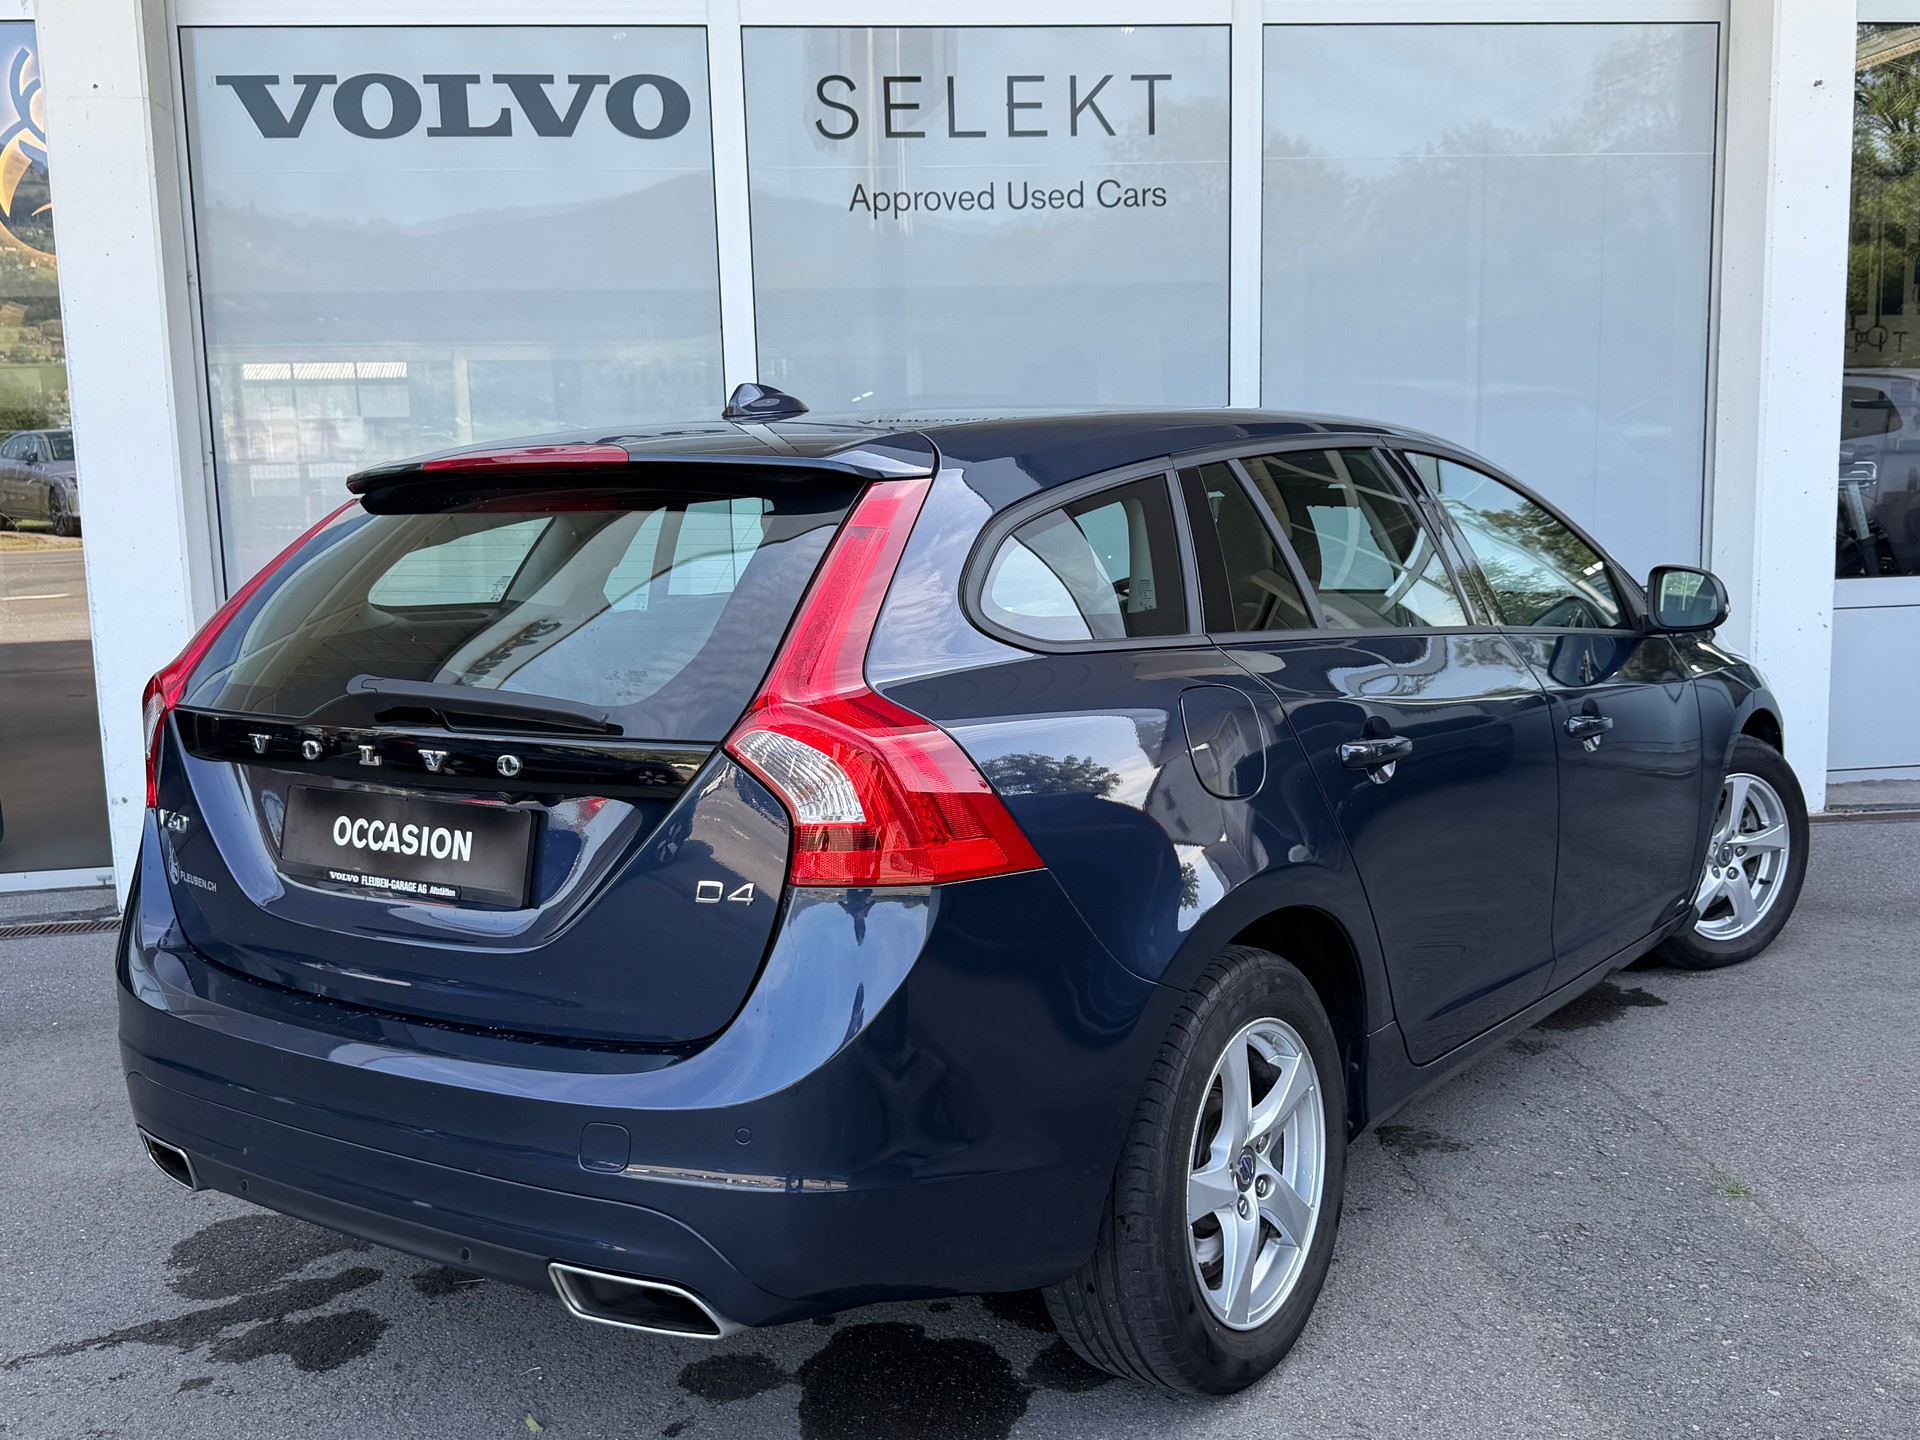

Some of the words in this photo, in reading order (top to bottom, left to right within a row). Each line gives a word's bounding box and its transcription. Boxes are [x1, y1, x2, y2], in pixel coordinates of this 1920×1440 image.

[215, 73, 691, 139] VOLVO
[815, 74, 1172, 140] SELEKT
[849, 182, 995, 220] Approved
[1007, 180, 1084, 210] Used
[1096, 179, 1167, 208] Cars
[248, 733, 524, 778] VOLVO
[333, 815, 473, 862] OCCASION
[180, 870, 217, 892] FLEUBEN.CH
[329, 871, 359, 883] VOLVO
[361, 875, 417, 893] FLEUBEN-GARAGE
[417, 882, 428, 894] AG
[695, 880, 755, 906] D4
